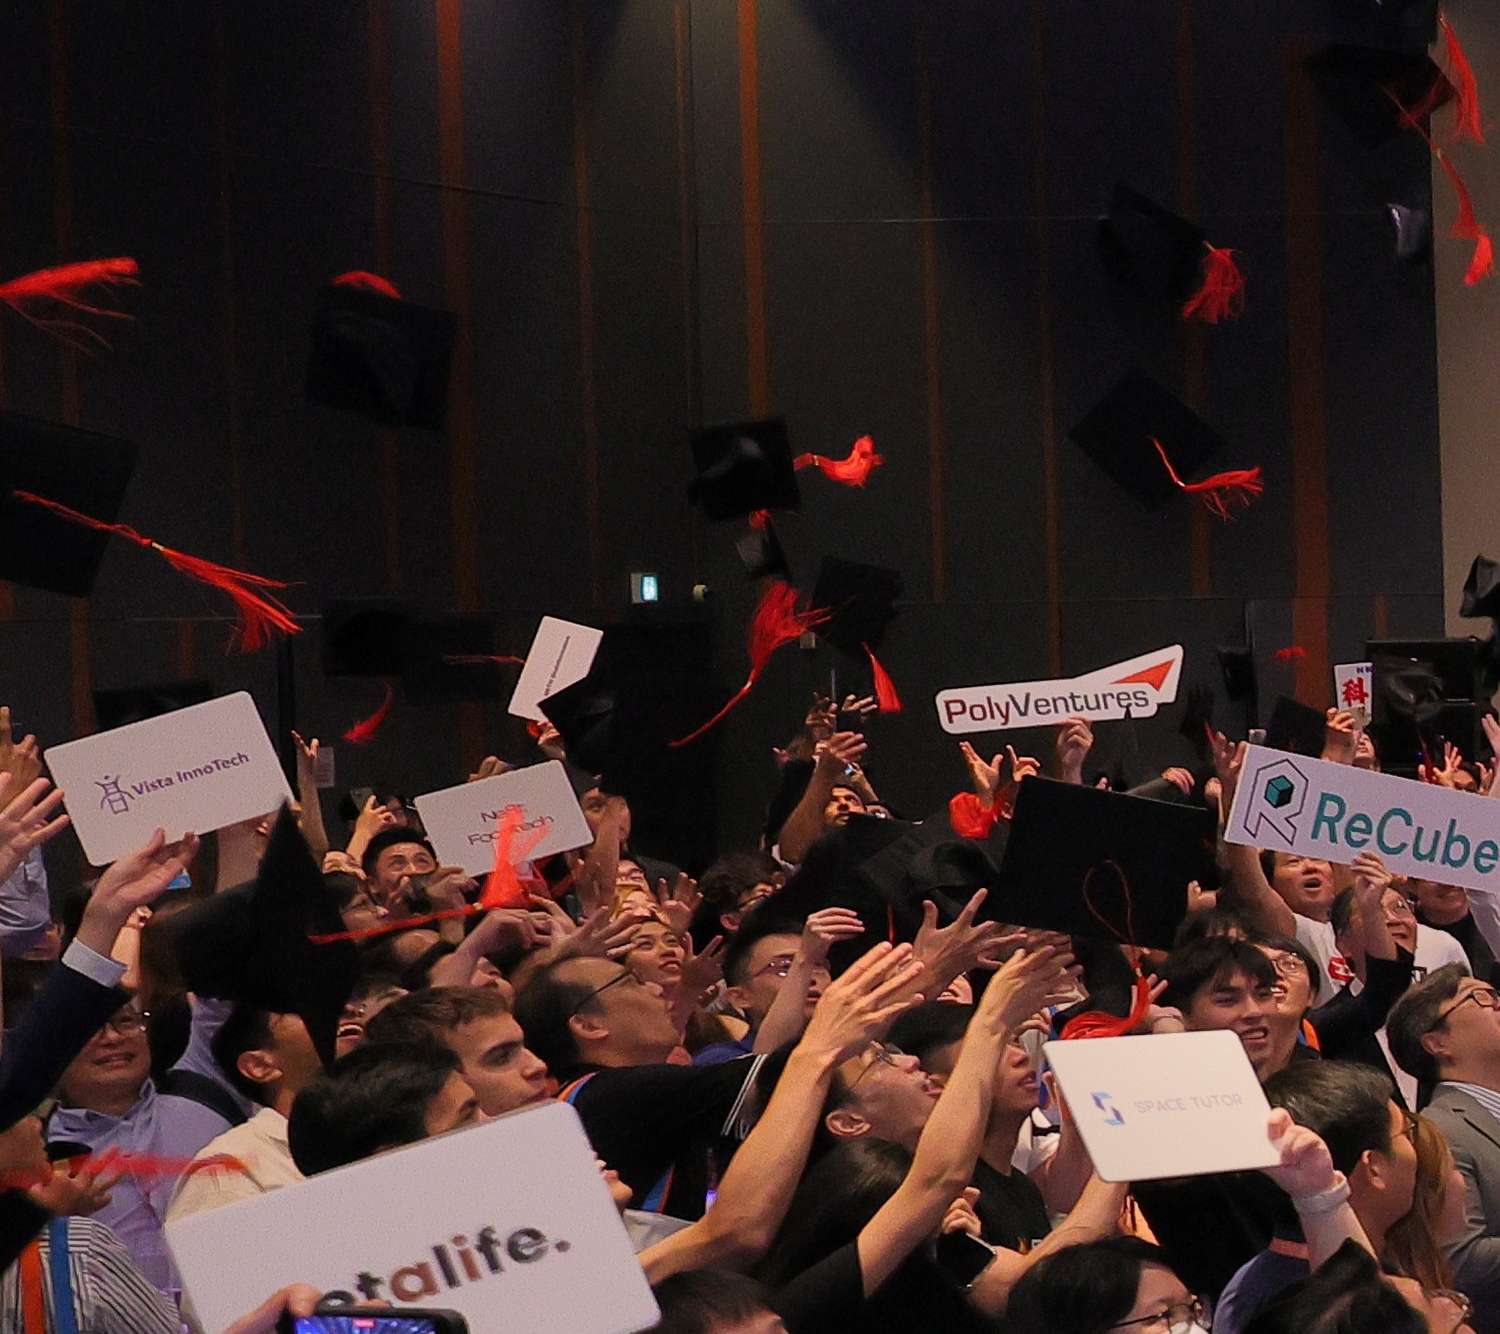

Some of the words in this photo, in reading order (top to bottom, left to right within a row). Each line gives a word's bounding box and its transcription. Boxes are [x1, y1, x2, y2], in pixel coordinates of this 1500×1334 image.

[944, 686, 1150, 726] PolyVentures
[132, 773, 175, 799] Vista
[177, 751, 250, 784] InnoTech
[1310, 792, 1500, 873] ReCube
[1134, 1097, 1186, 1114] SPACE
[1190, 1092, 1243, 1109] TUTOR
[316, 1223, 572, 1309] etalife.
